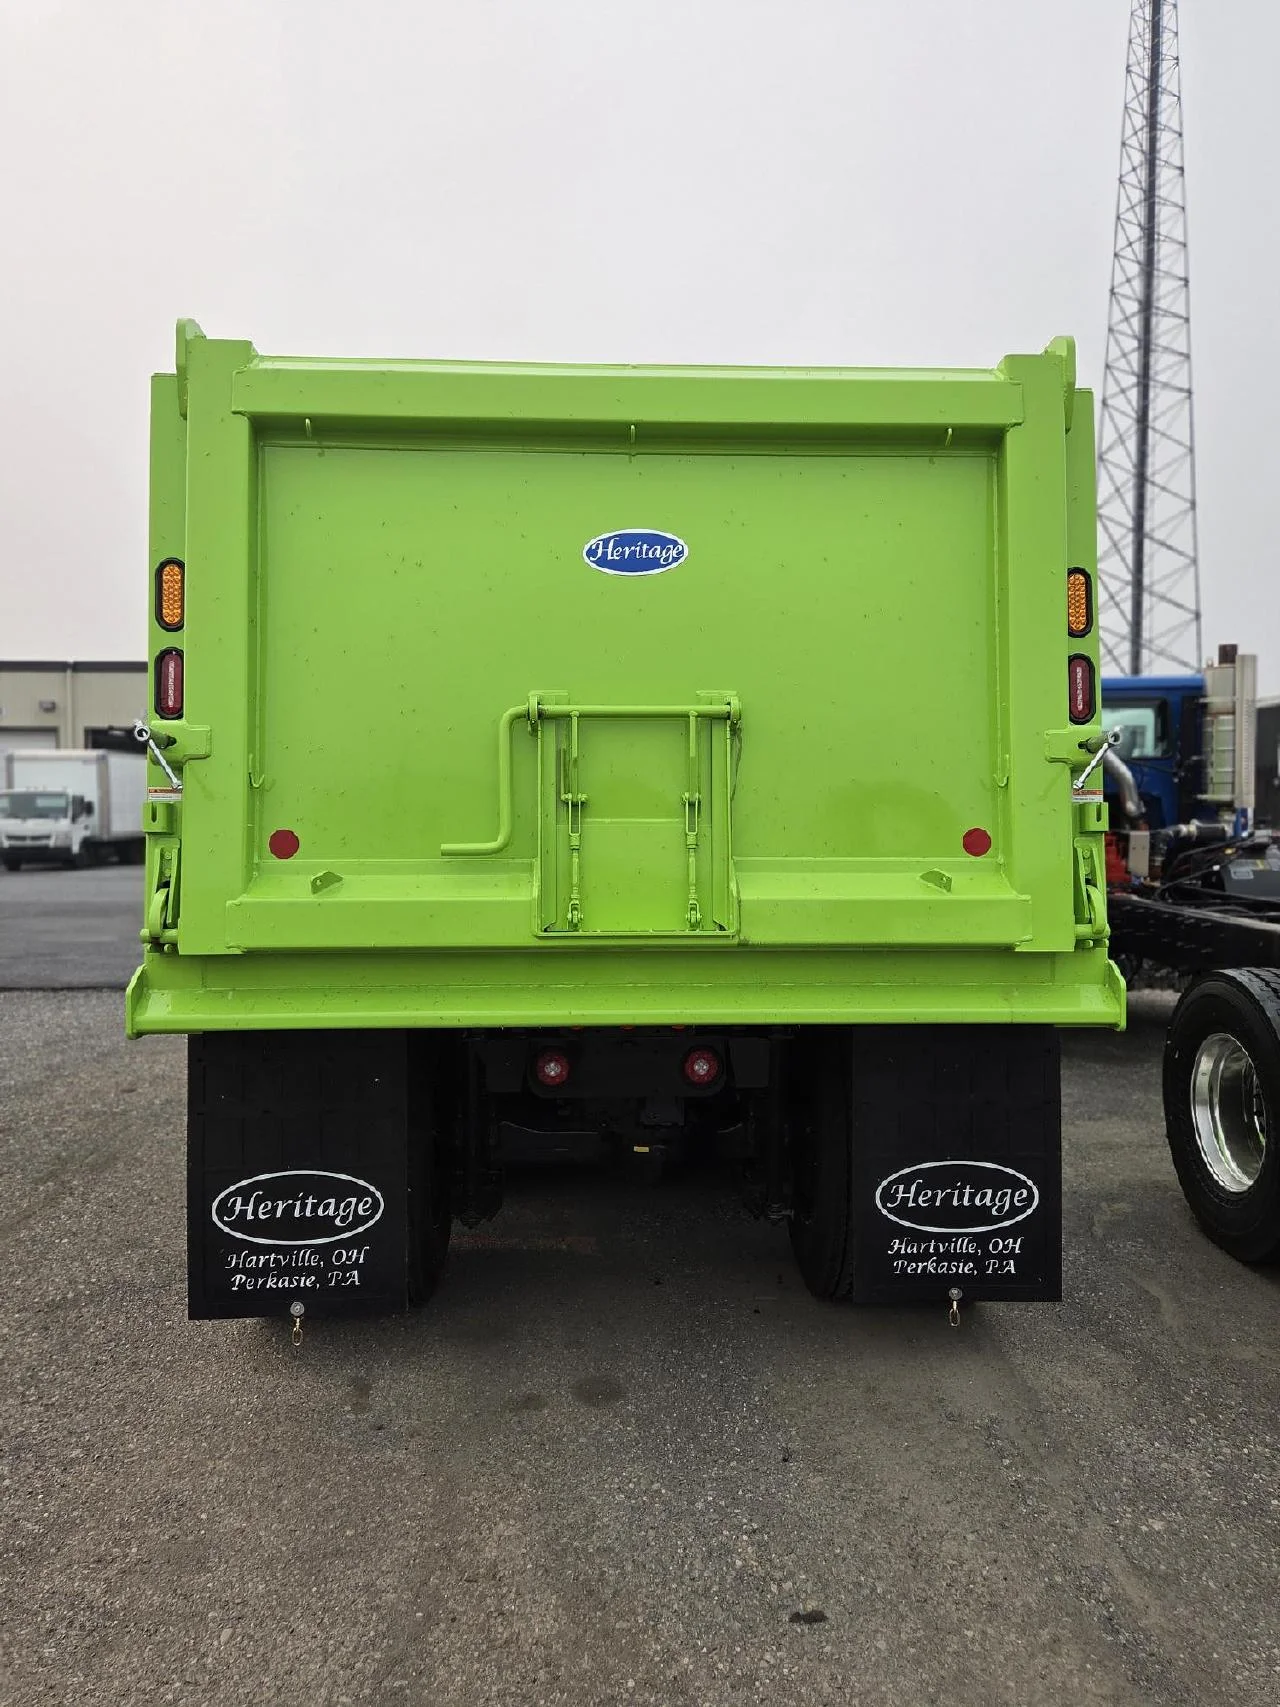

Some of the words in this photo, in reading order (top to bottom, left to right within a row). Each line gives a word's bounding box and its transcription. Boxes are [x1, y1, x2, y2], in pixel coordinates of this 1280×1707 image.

[589, 537, 683, 565] Heritage
[223, 1191, 373, 1226] Heritage
[886, 1179, 1028, 1216] Heritage
[225, 1248, 324, 1269] Hartville,
[332, 1246, 370, 1265] OH
[887, 1236, 982, 1257] Hartville,
[989, 1236, 1025, 1254] OH
[893, 1256, 979, 1276] Perkasie,
[985, 1259, 1017, 1275] PA
[231, 1271, 320, 1291] Perkasie,
[328, 1269, 361, 1287] PA
